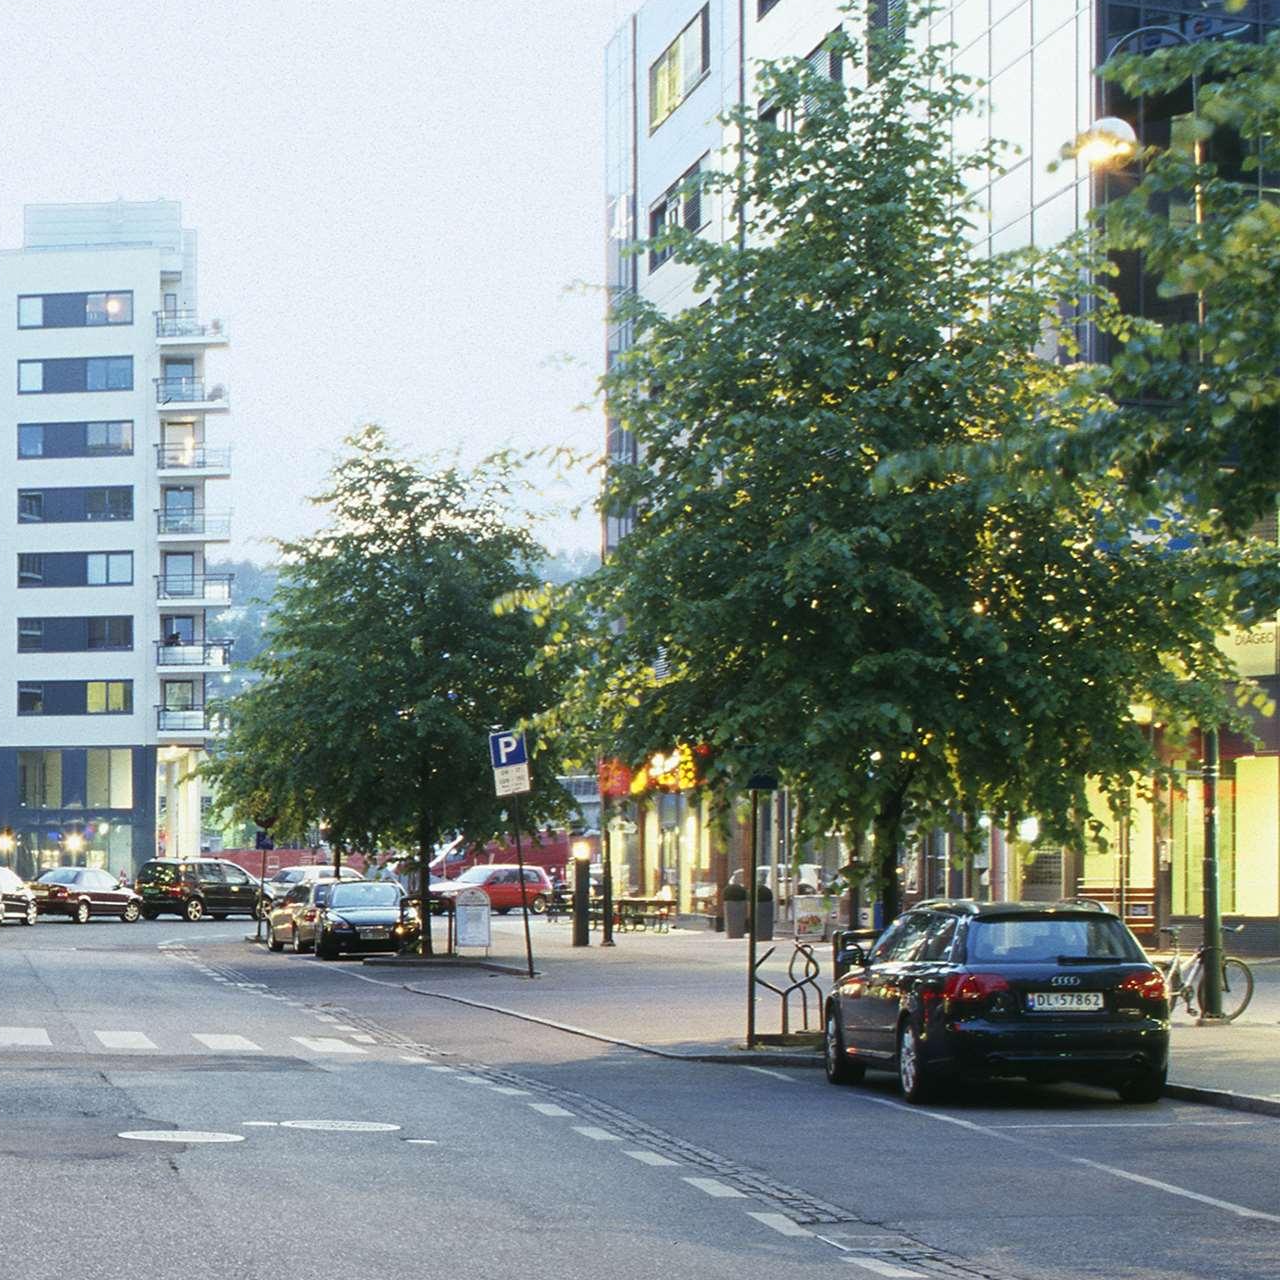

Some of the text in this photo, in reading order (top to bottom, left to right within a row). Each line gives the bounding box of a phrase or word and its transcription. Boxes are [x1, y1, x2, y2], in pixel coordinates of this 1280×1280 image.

[498, 736, 517, 763] P
[1036, 994, 1101, 1006] DL 57862
